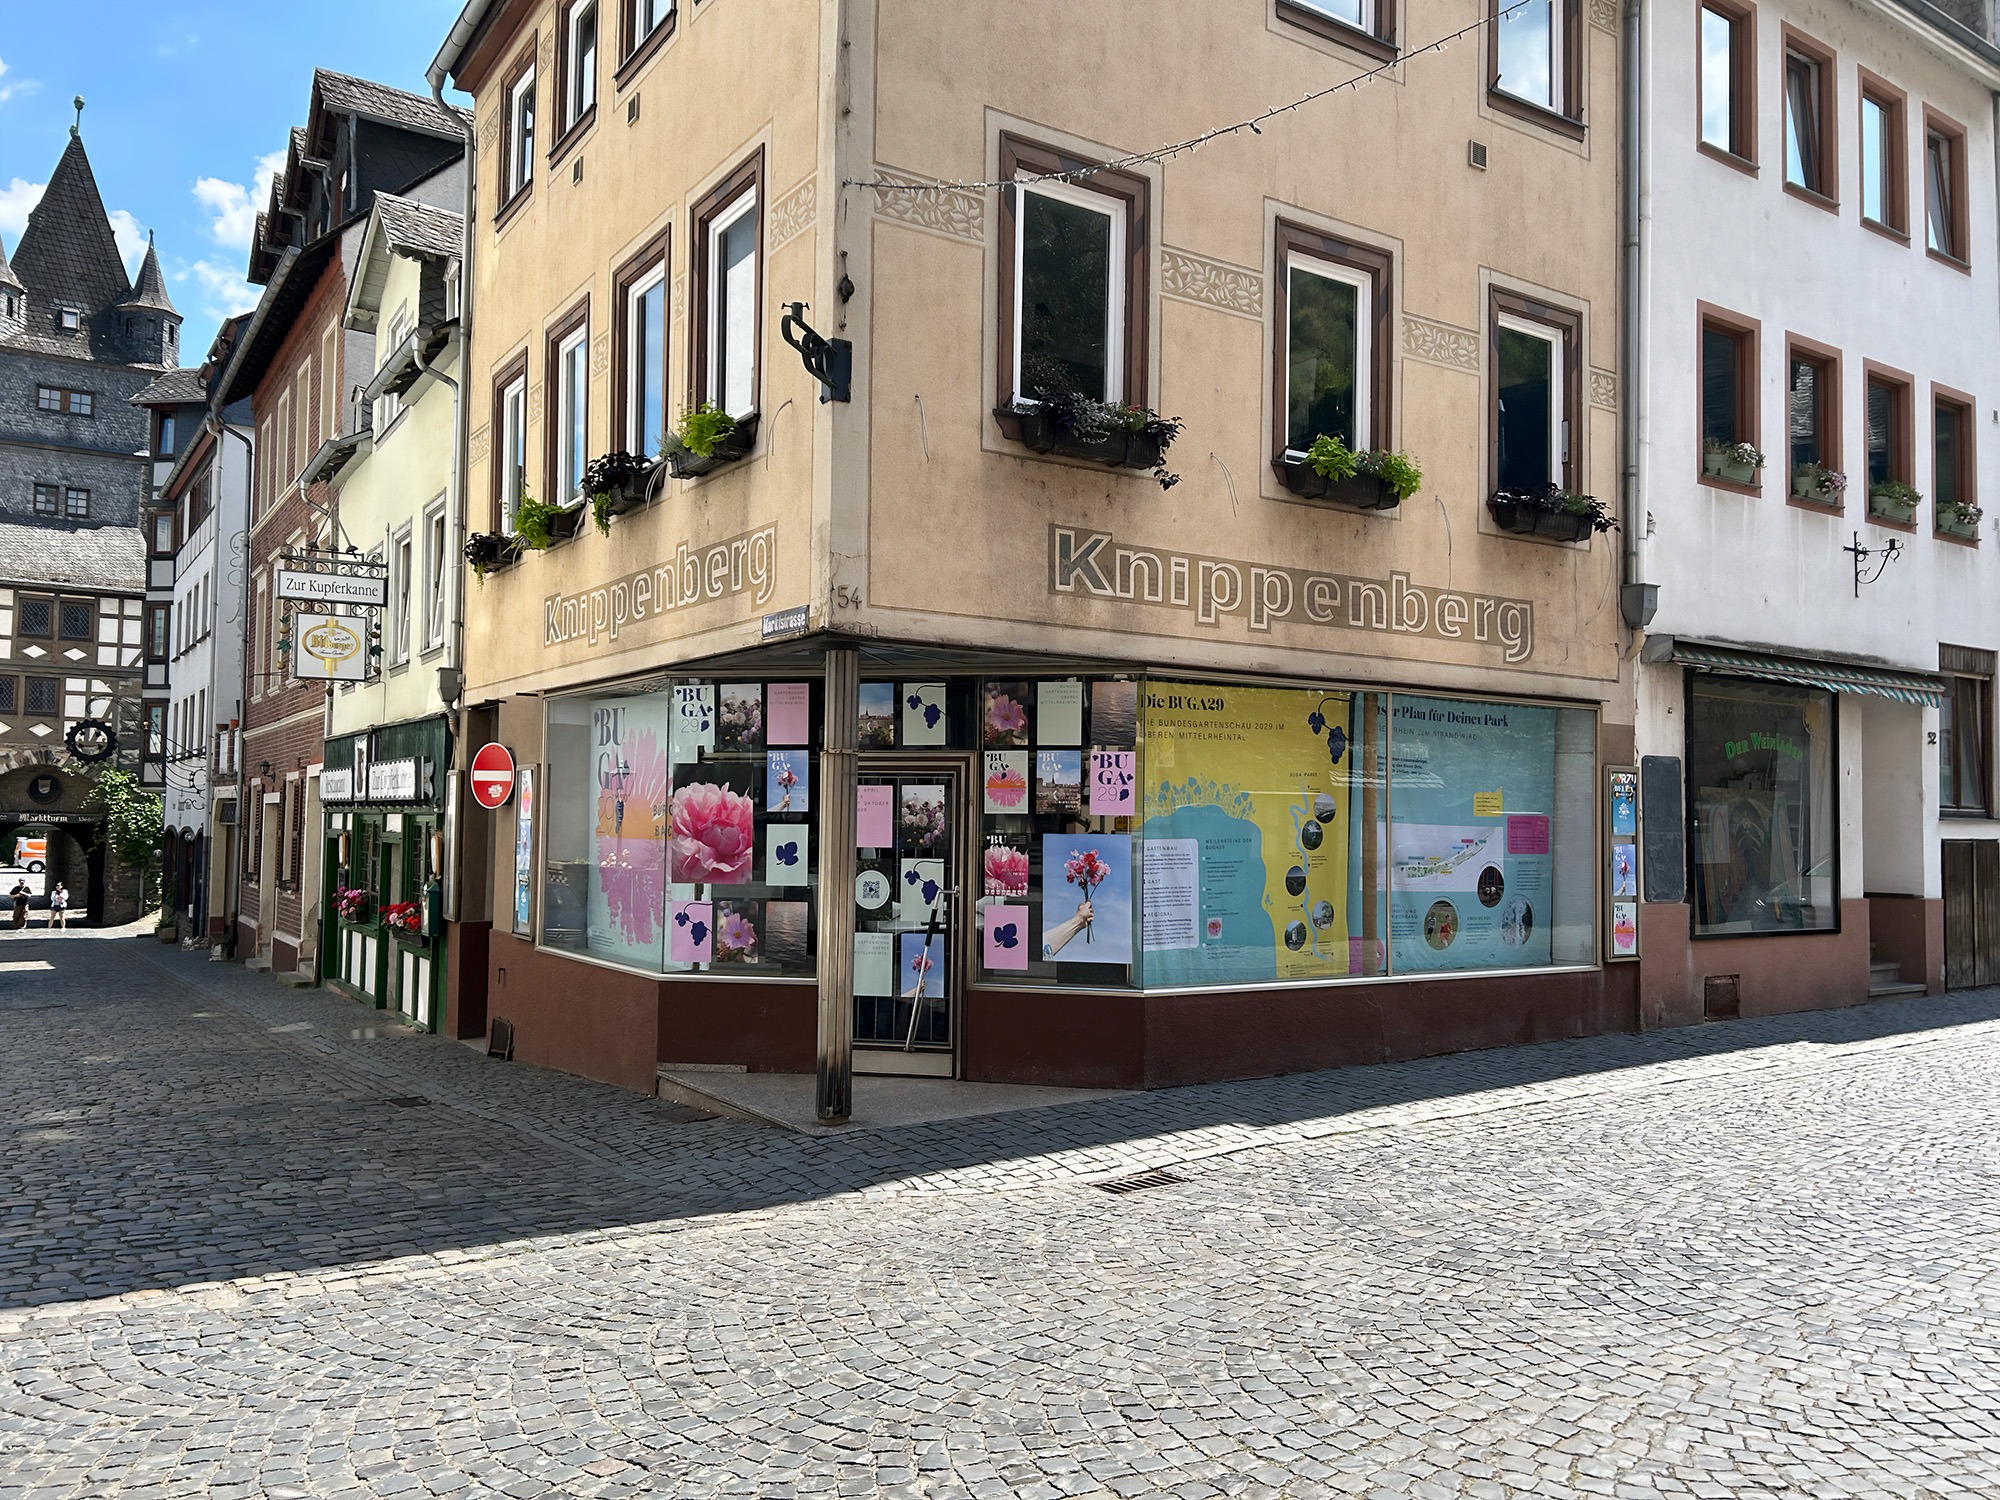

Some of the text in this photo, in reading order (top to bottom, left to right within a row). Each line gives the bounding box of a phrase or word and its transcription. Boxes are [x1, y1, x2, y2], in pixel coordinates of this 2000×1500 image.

[286, 577, 379, 597] Zur Kupferkanne
[544, 527, 776, 646] Knippenberg
[837, 585, 863, 609] 54
[1055, 528, 1532, 663] Knippenberg
[681, 688, 709, 702] BU
[1140, 694, 1225, 711] Die BUGA29
[681, 703, 709, 717] GA
[1402, 705, 1426, 721] Plan
[1428, 708, 1445, 722] für
[1484, 714, 1509, 727] Park
[598, 707, 627, 746] BU
[681, 719, 700, 733] 29
[1158, 719, 1252, 730] BUNDESGARTENSCHAU
[1254, 722, 1273, 731] 2029
[1179, 732, 1247, 742] MITTELRHEINTAL
[1099, 754, 1129, 769] BU
[1098, 770, 1129, 785] GA
[1097, 787, 1118, 802] 29
[19, 813, 68, 822] Marktturm
